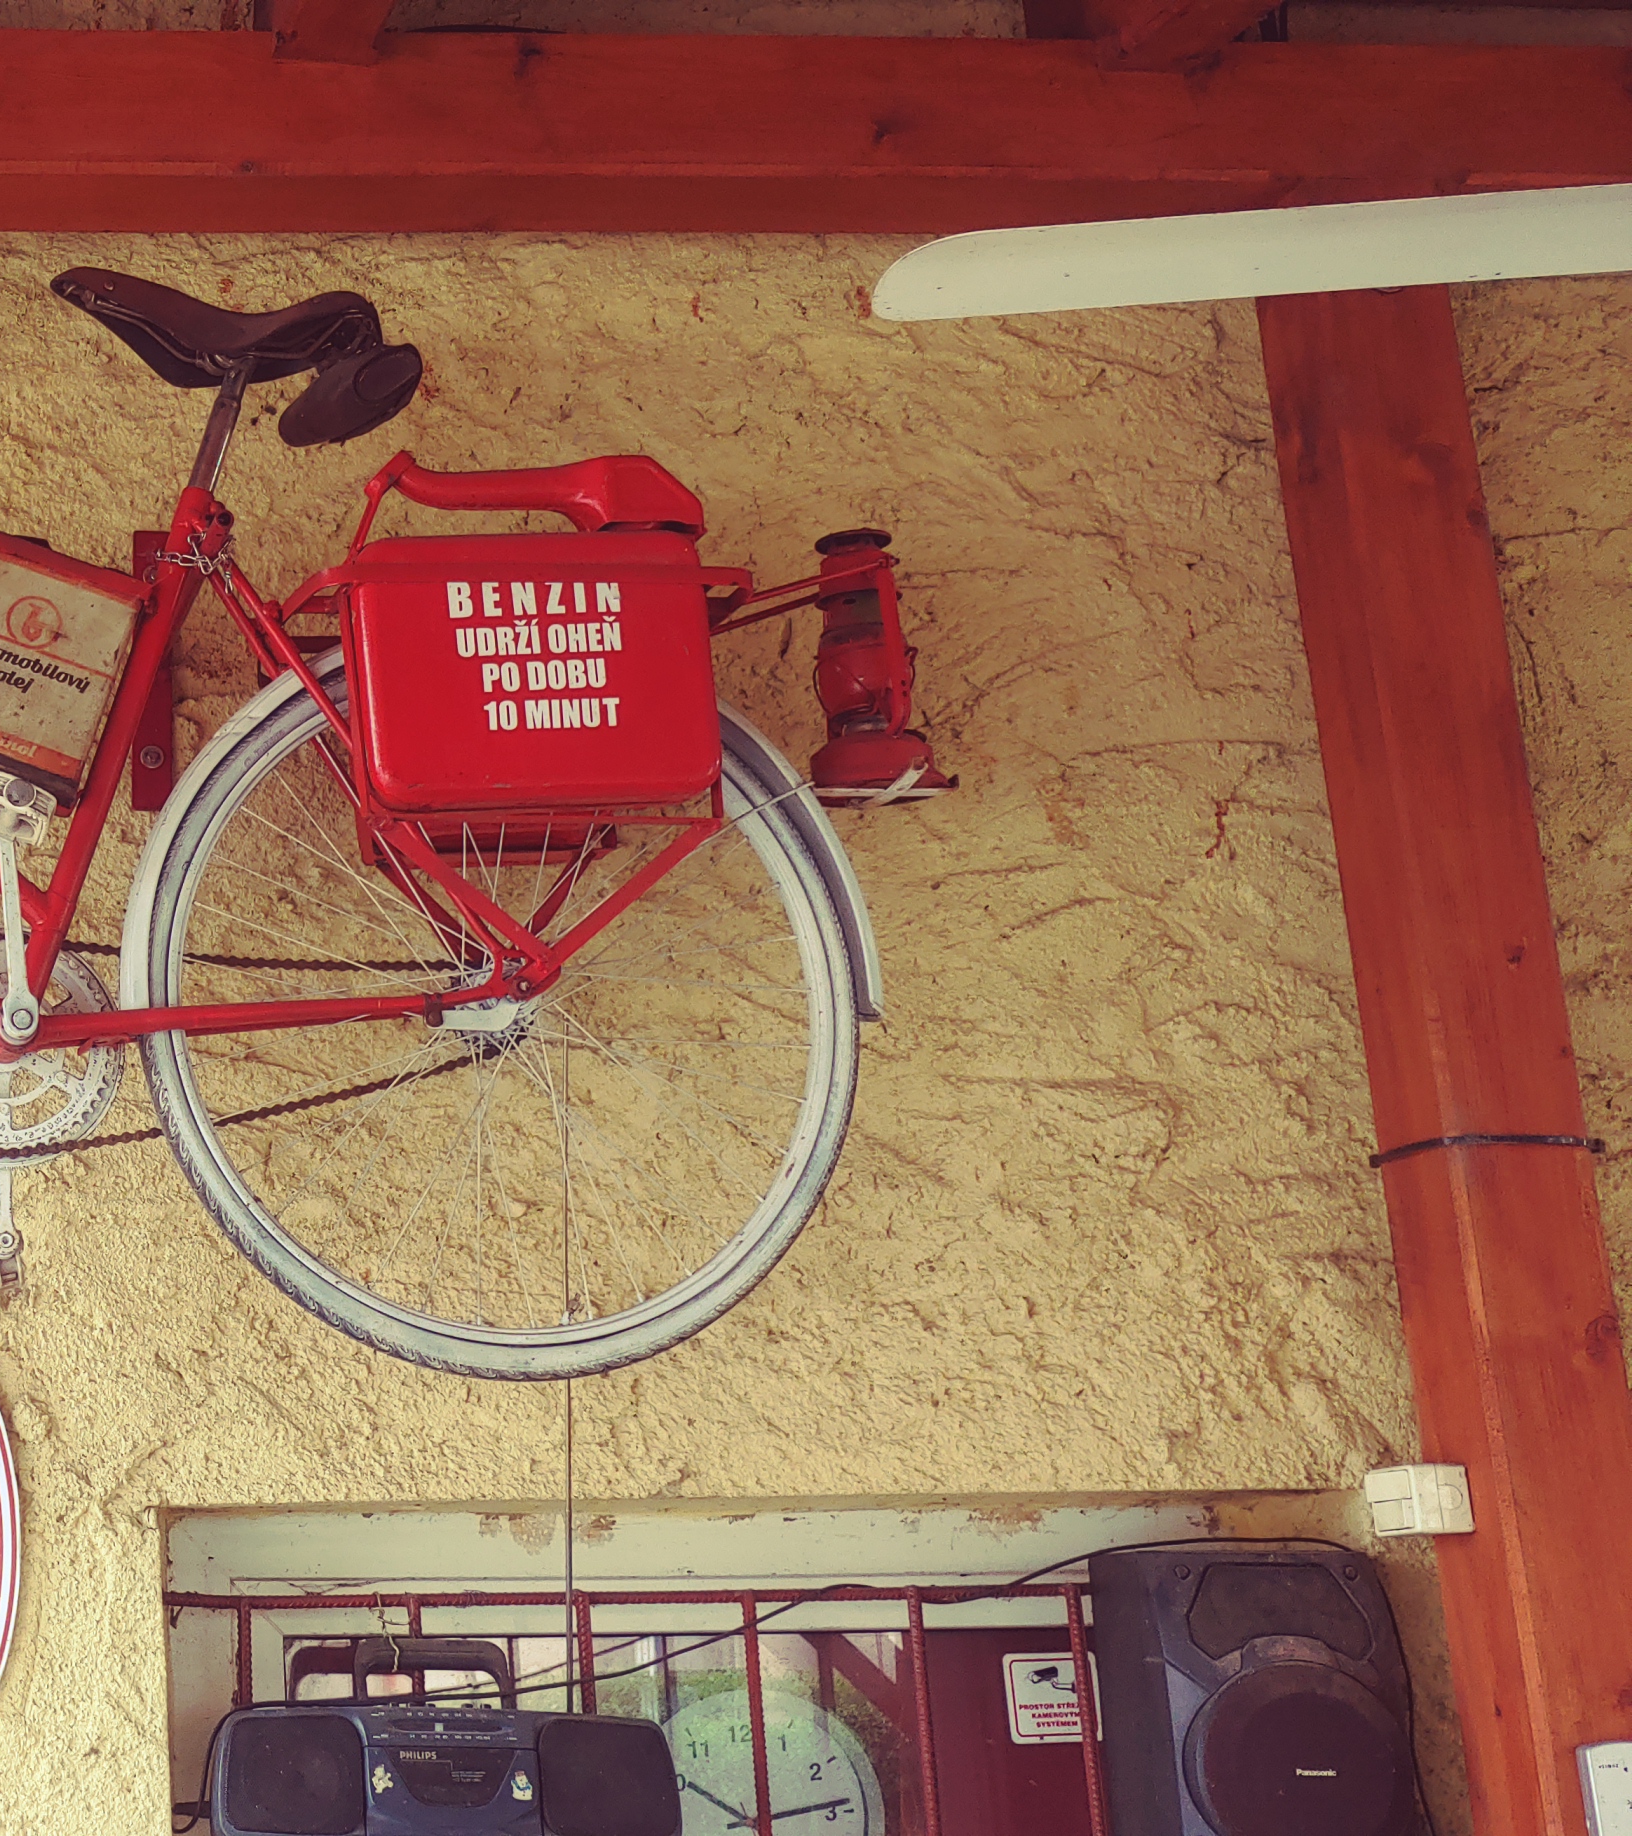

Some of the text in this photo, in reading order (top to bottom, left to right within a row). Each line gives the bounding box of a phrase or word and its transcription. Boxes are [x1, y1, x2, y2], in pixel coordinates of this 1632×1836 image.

[447, 581, 621, 618] BENZIN
[456, 616, 622, 657] UDRŽÍ OHEŇ
[482, 658, 606, 692] PO DOBU
[484, 697, 619, 730] 10 MINUT
[728, 1724, 752, 1743] 12
[399, 1751, 437, 1760] PHILIPS
[686, 1740, 709, 1758] 11
[809, 1763, 822, 1781] 2
[1296, 1768, 1337, 1777] Panasonic
[825, 1805, 837, 1821] 3
